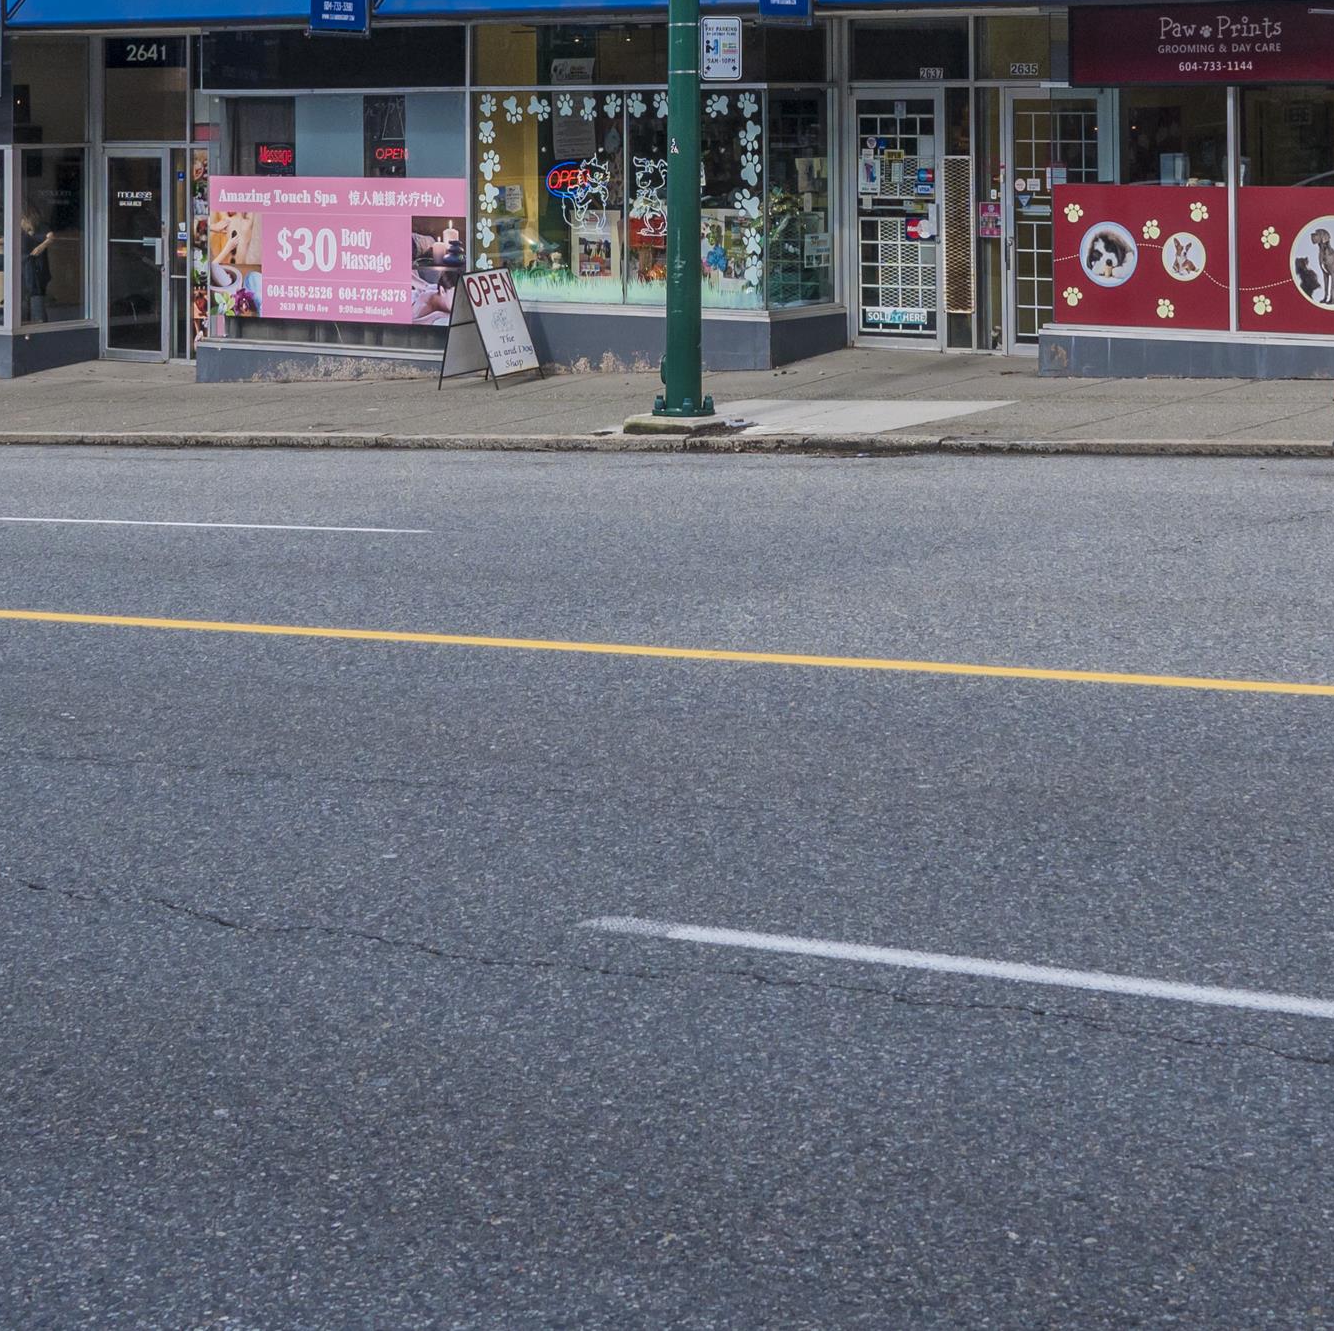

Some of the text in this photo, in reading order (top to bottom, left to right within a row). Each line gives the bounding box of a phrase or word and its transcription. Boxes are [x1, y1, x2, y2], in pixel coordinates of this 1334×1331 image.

[1158, 15, 1282, 39] Paw Prints
[126, 44, 166, 61] 2641
[1158, 42, 1282, 54] GROOMING & DAY CARE
[920, 68, 943, 78] 2637
[1010, 63, 1038, 75] 2635
[1179, 61, 1253, 71] 604-733-1144
[259, 146, 293, 166] Massage
[375, 148, 409, 160] OPEN
[117, 191, 152, 199] mousse
[219, 189, 337, 206] Amazing Touch Spa
[348, 190, 445, 207] 惊人触摸水疗中心
[341, 228, 372, 249] Body
[277, 227, 337, 272] $30
[341, 252, 392, 273] Massage
[267, 285, 332, 299] 604-558-2526
[467, 271, 516, 307] OPEN
[296, 303, 304, 311] W
[304, 303, 316, 312] 4th
[868, 312, 926, 322] SOLD HERE
[499, 334, 515, 343] The
[488, 345, 534, 359] Cat and Dog
[505, 357, 524, 369] Shop
